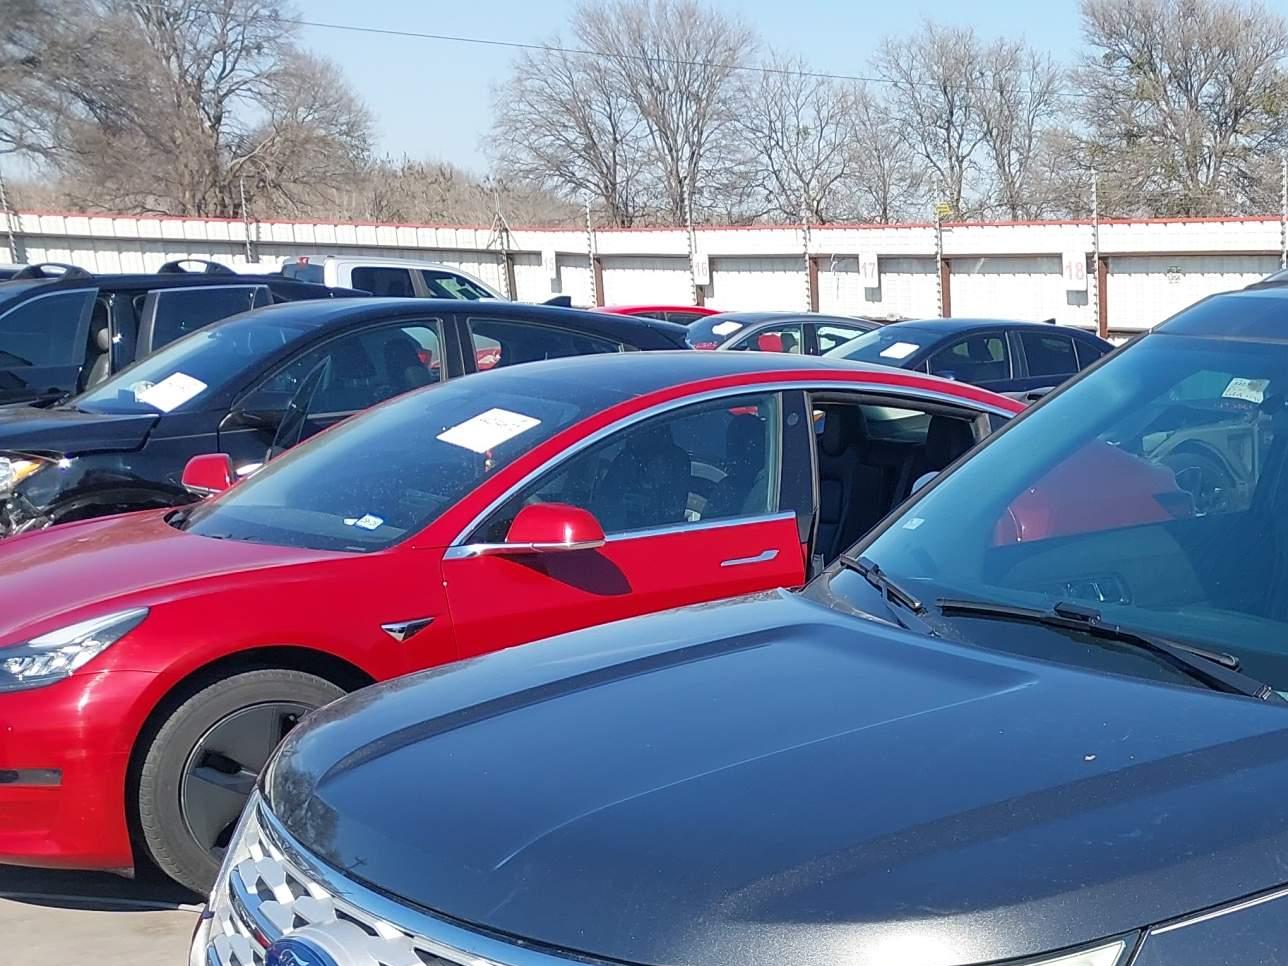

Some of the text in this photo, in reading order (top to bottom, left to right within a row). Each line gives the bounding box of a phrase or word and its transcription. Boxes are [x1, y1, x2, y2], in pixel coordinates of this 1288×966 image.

[694, 261, 708, 276] 16
[862, 261, 876, 278] 17
[1065, 260, 1084, 280] 18
